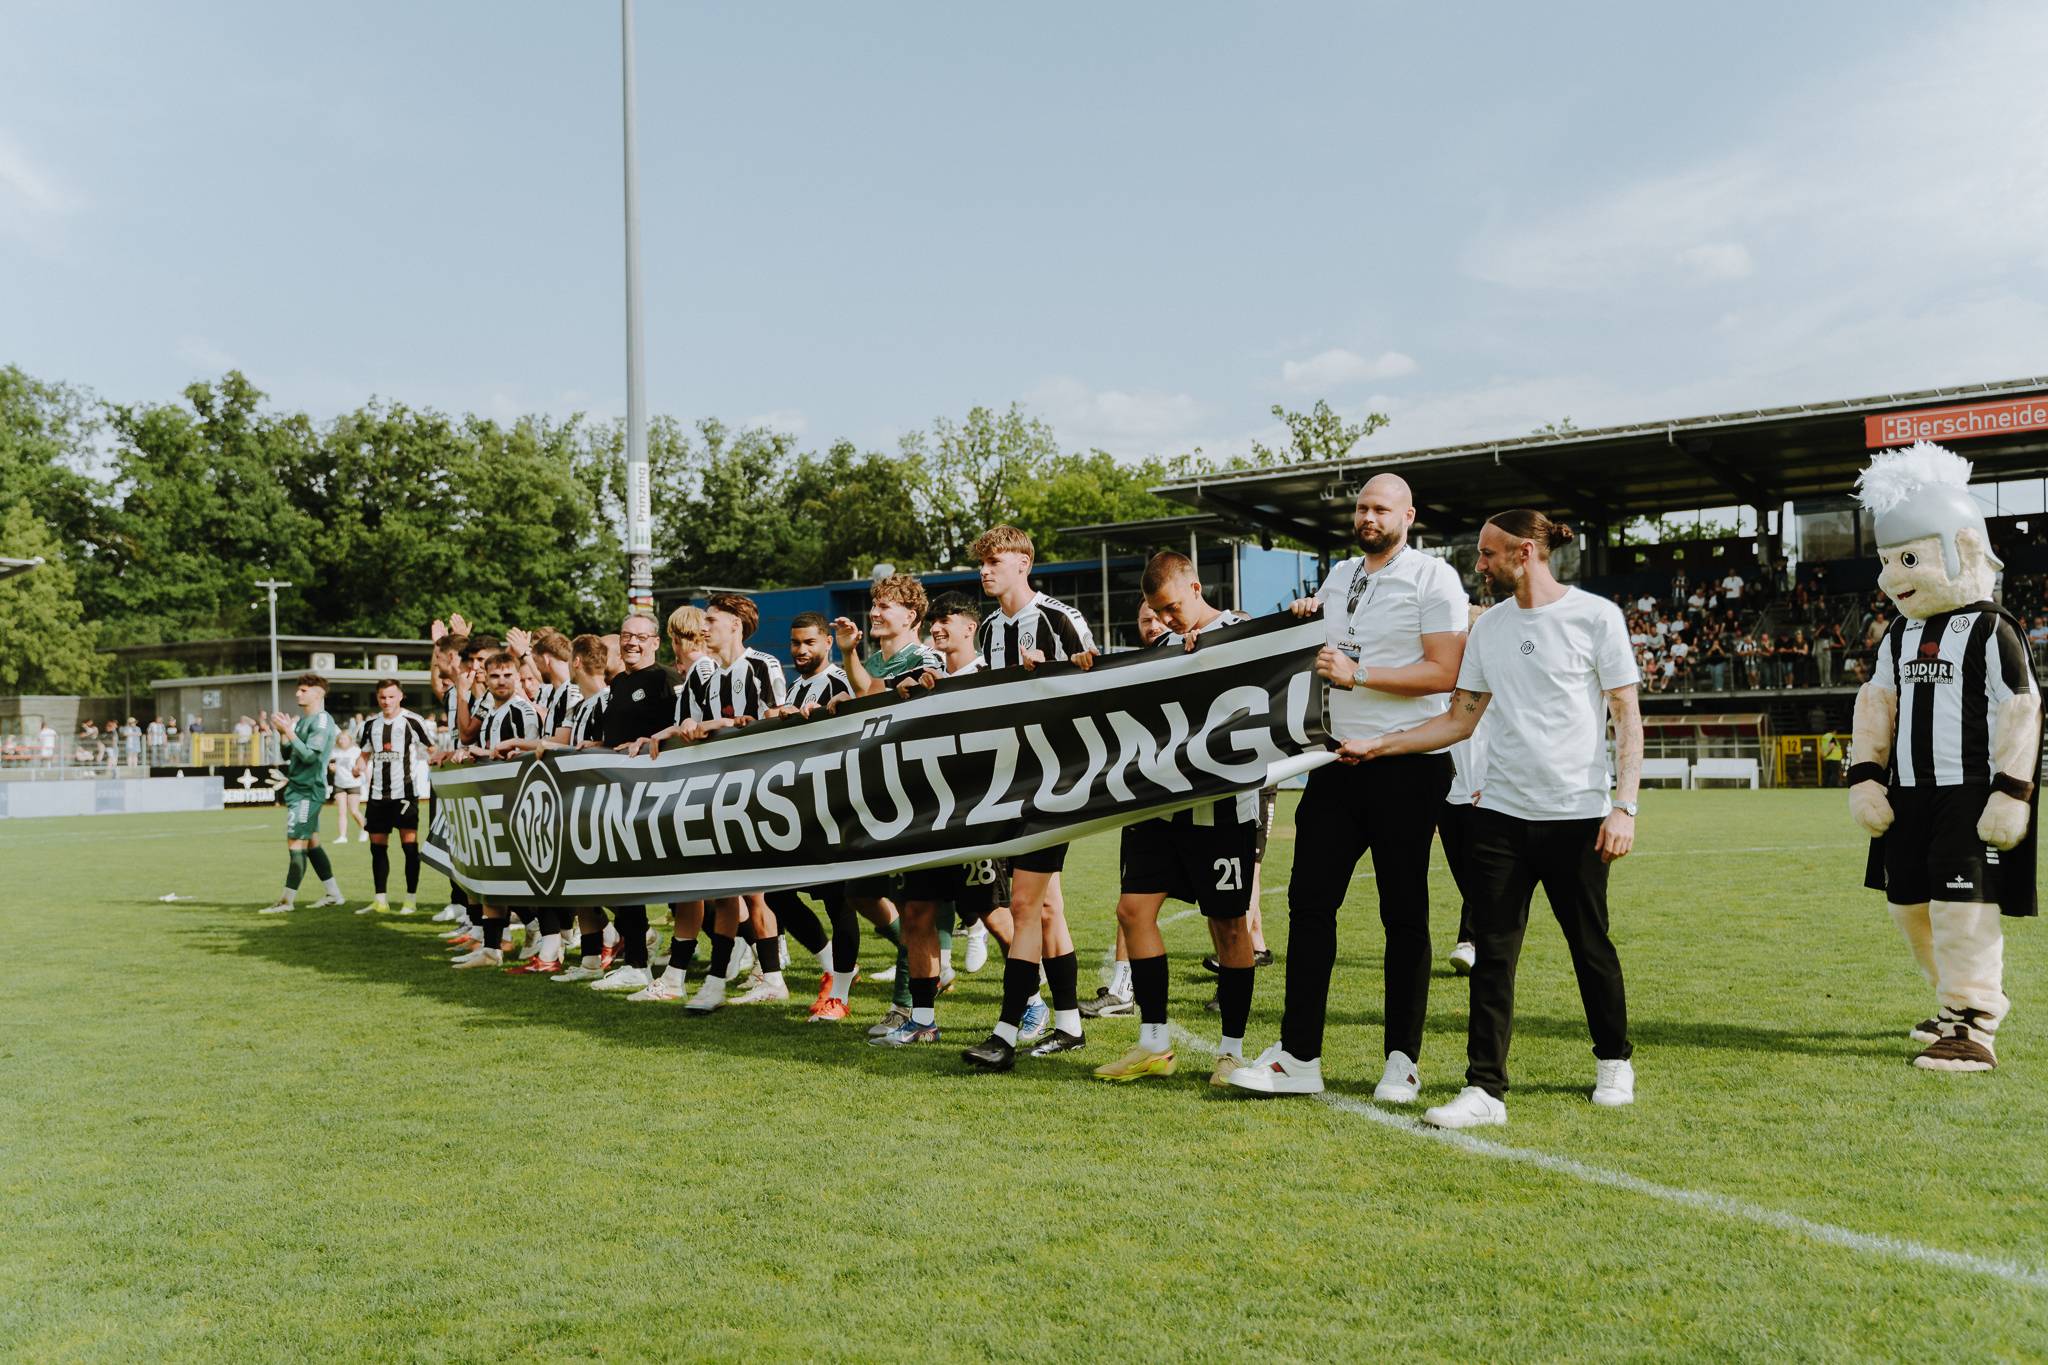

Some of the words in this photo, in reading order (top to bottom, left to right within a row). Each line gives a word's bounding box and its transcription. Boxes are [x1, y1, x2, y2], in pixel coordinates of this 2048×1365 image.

[400, 800, 410, 815] 7
[963, 858, 997, 887] 28
[1213, 857, 1243, 890] 21
